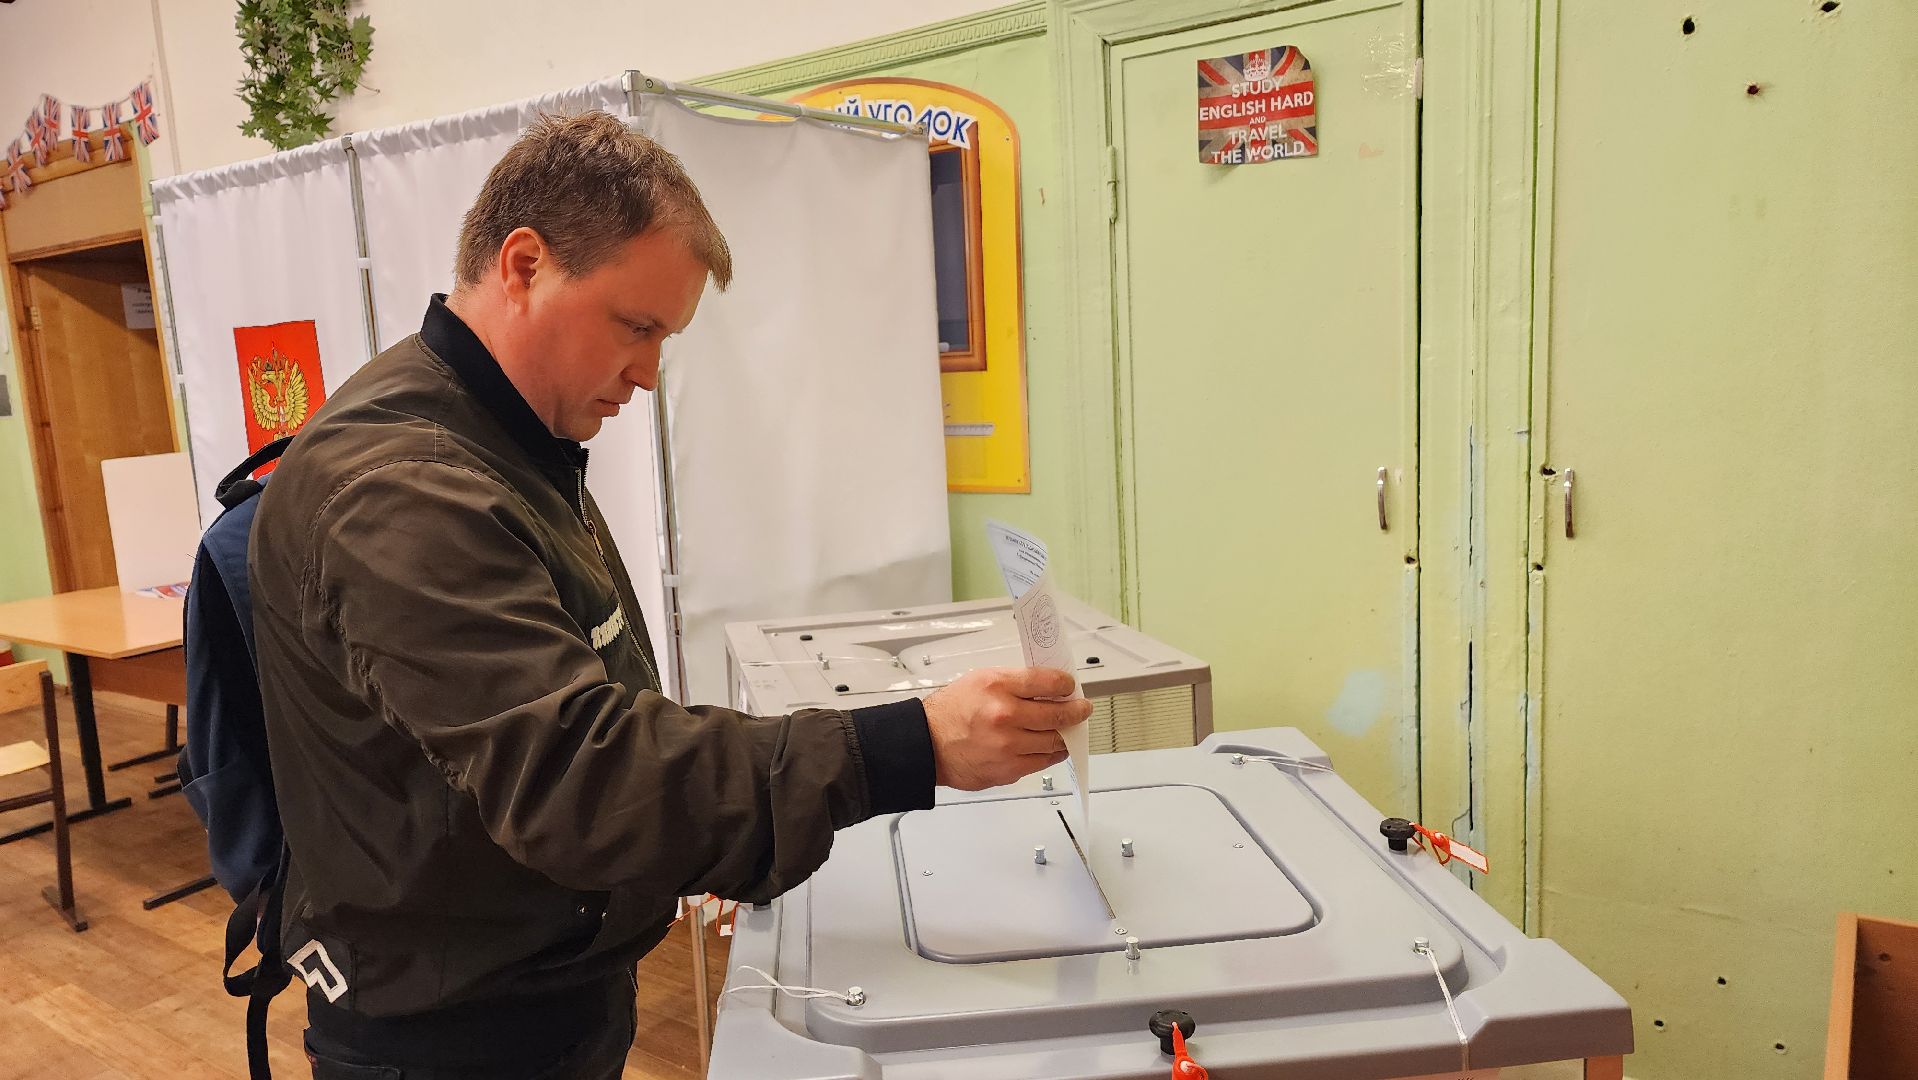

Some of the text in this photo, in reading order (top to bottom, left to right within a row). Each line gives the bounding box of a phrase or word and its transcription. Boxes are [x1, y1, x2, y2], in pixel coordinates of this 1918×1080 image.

[1231, 77, 1284, 98] STUDY
[1199, 91, 1314, 121] ENGLISH HARD
[1249, 116, 1266, 125] AND
[1229, 124, 1287, 145] TRAVEL
[1210, 141, 1305, 164] THE WORLD
